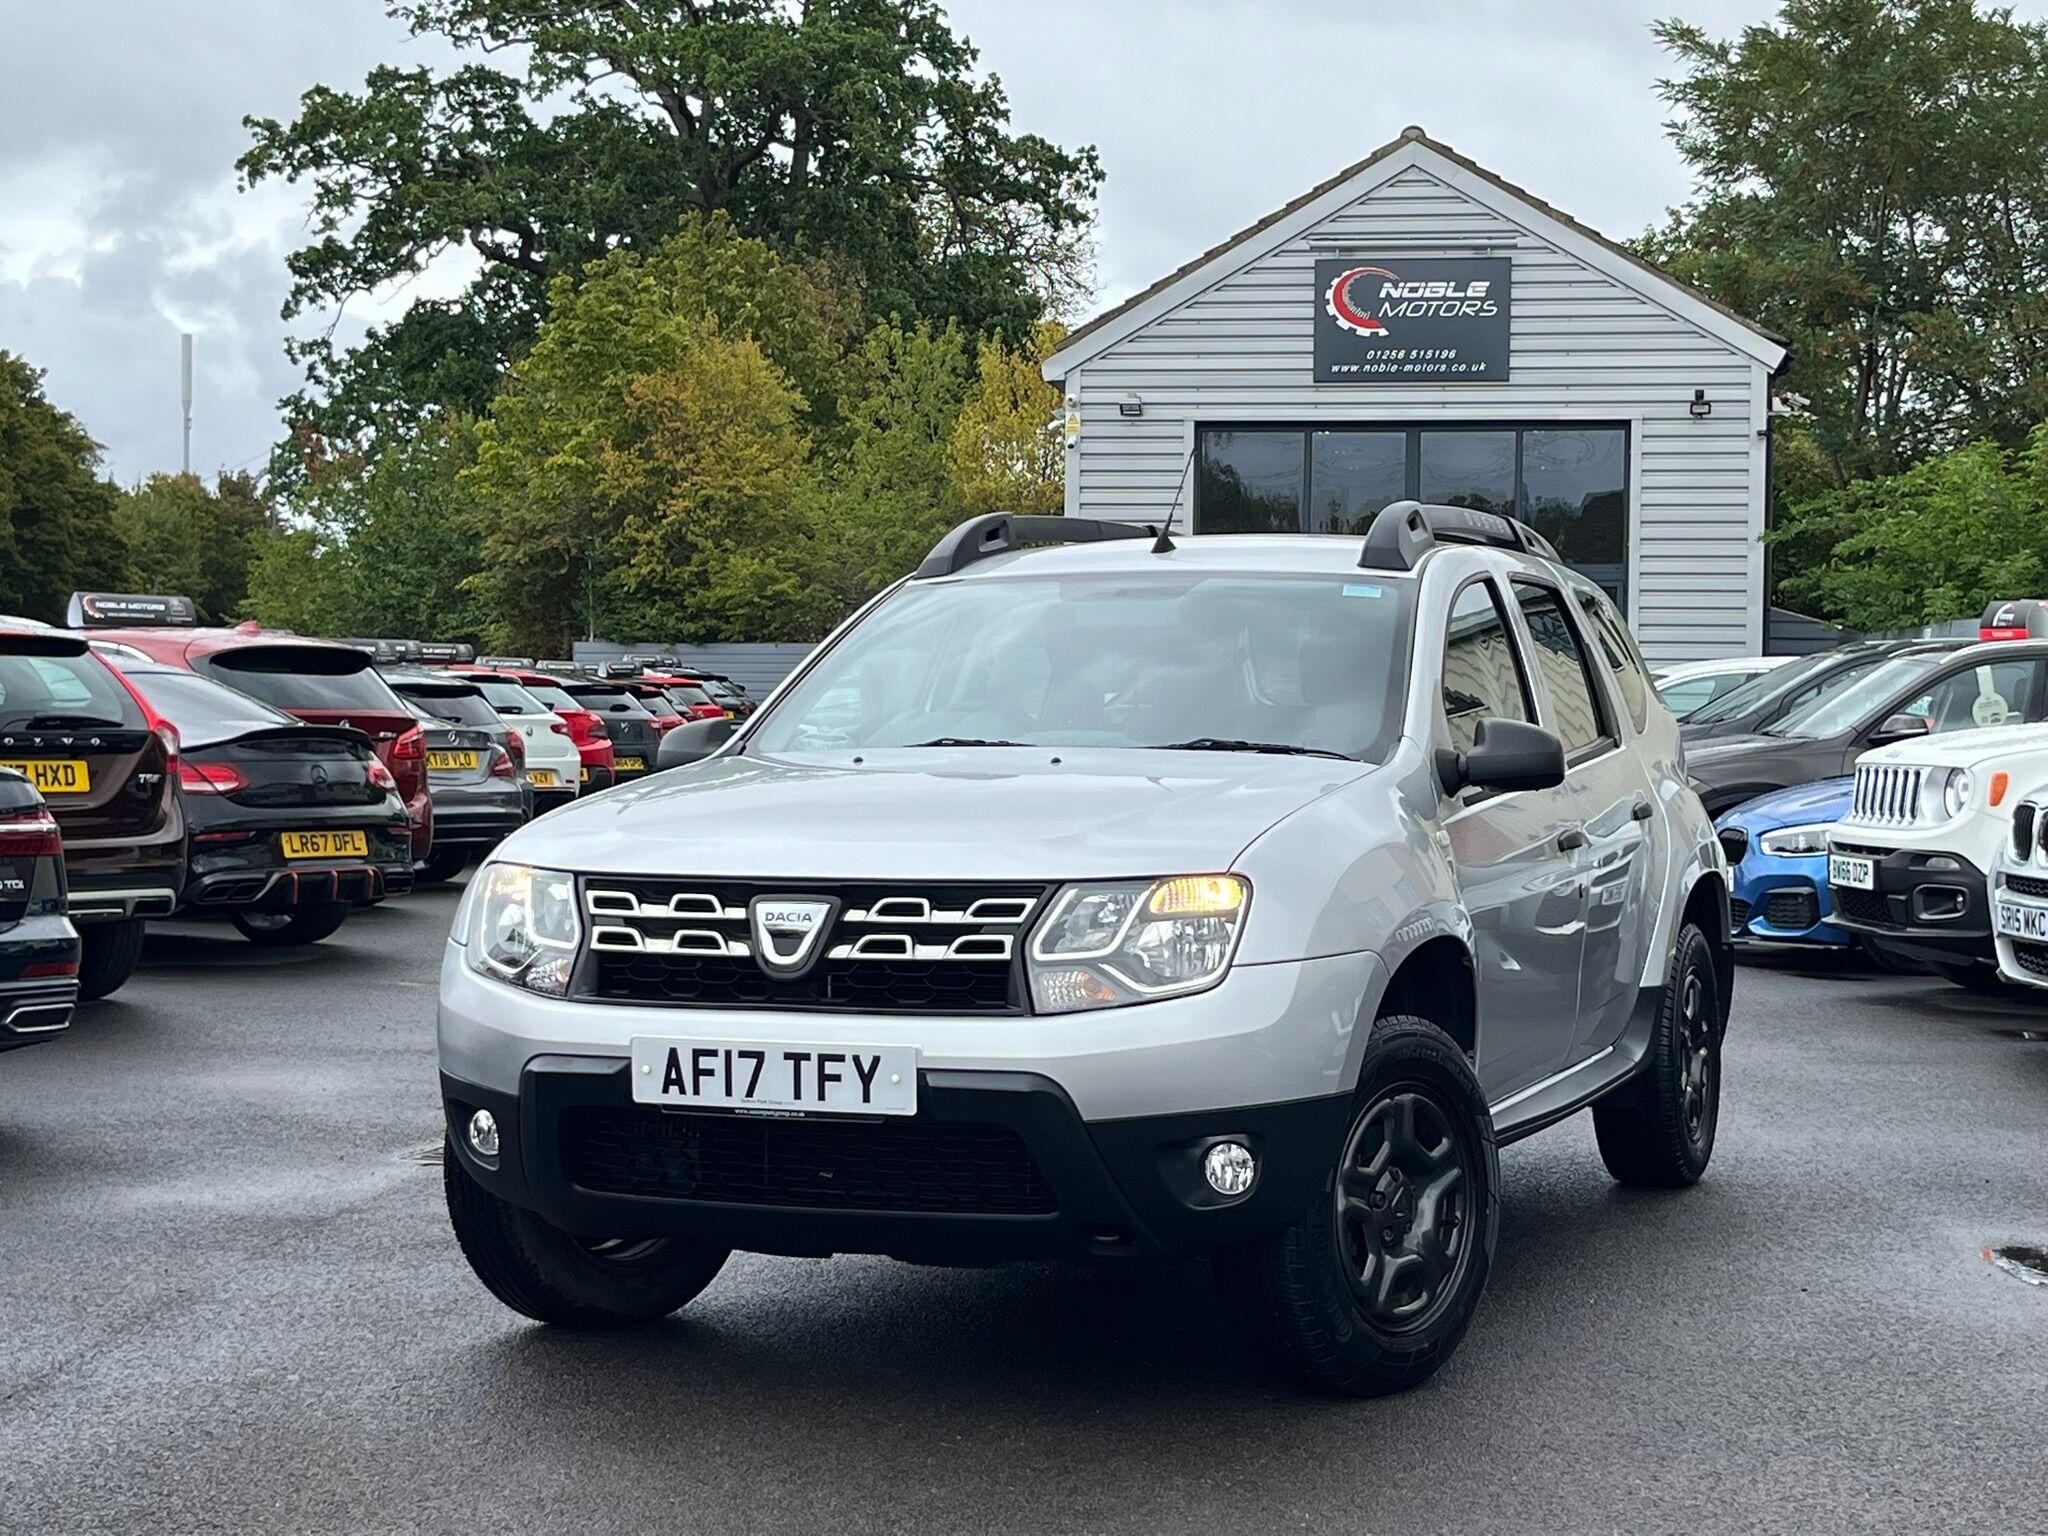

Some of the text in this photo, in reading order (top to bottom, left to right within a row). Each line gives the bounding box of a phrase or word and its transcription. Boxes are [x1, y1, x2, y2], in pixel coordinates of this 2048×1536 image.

[1379, 281, 1491, 298] NOBLE
[1378, 300, 1498, 318] MOTORS
[1331, 361, 1487, 374] www.noble-motors.co.uk
[34, 764, 77, 787] HXD
[288, 833, 362, 854] LR67 DFL
[765, 911, 812, 922] DACIA
[2000, 905, 2021, 932] SR15
[661, 1047, 881, 1104] AF17 TFY
